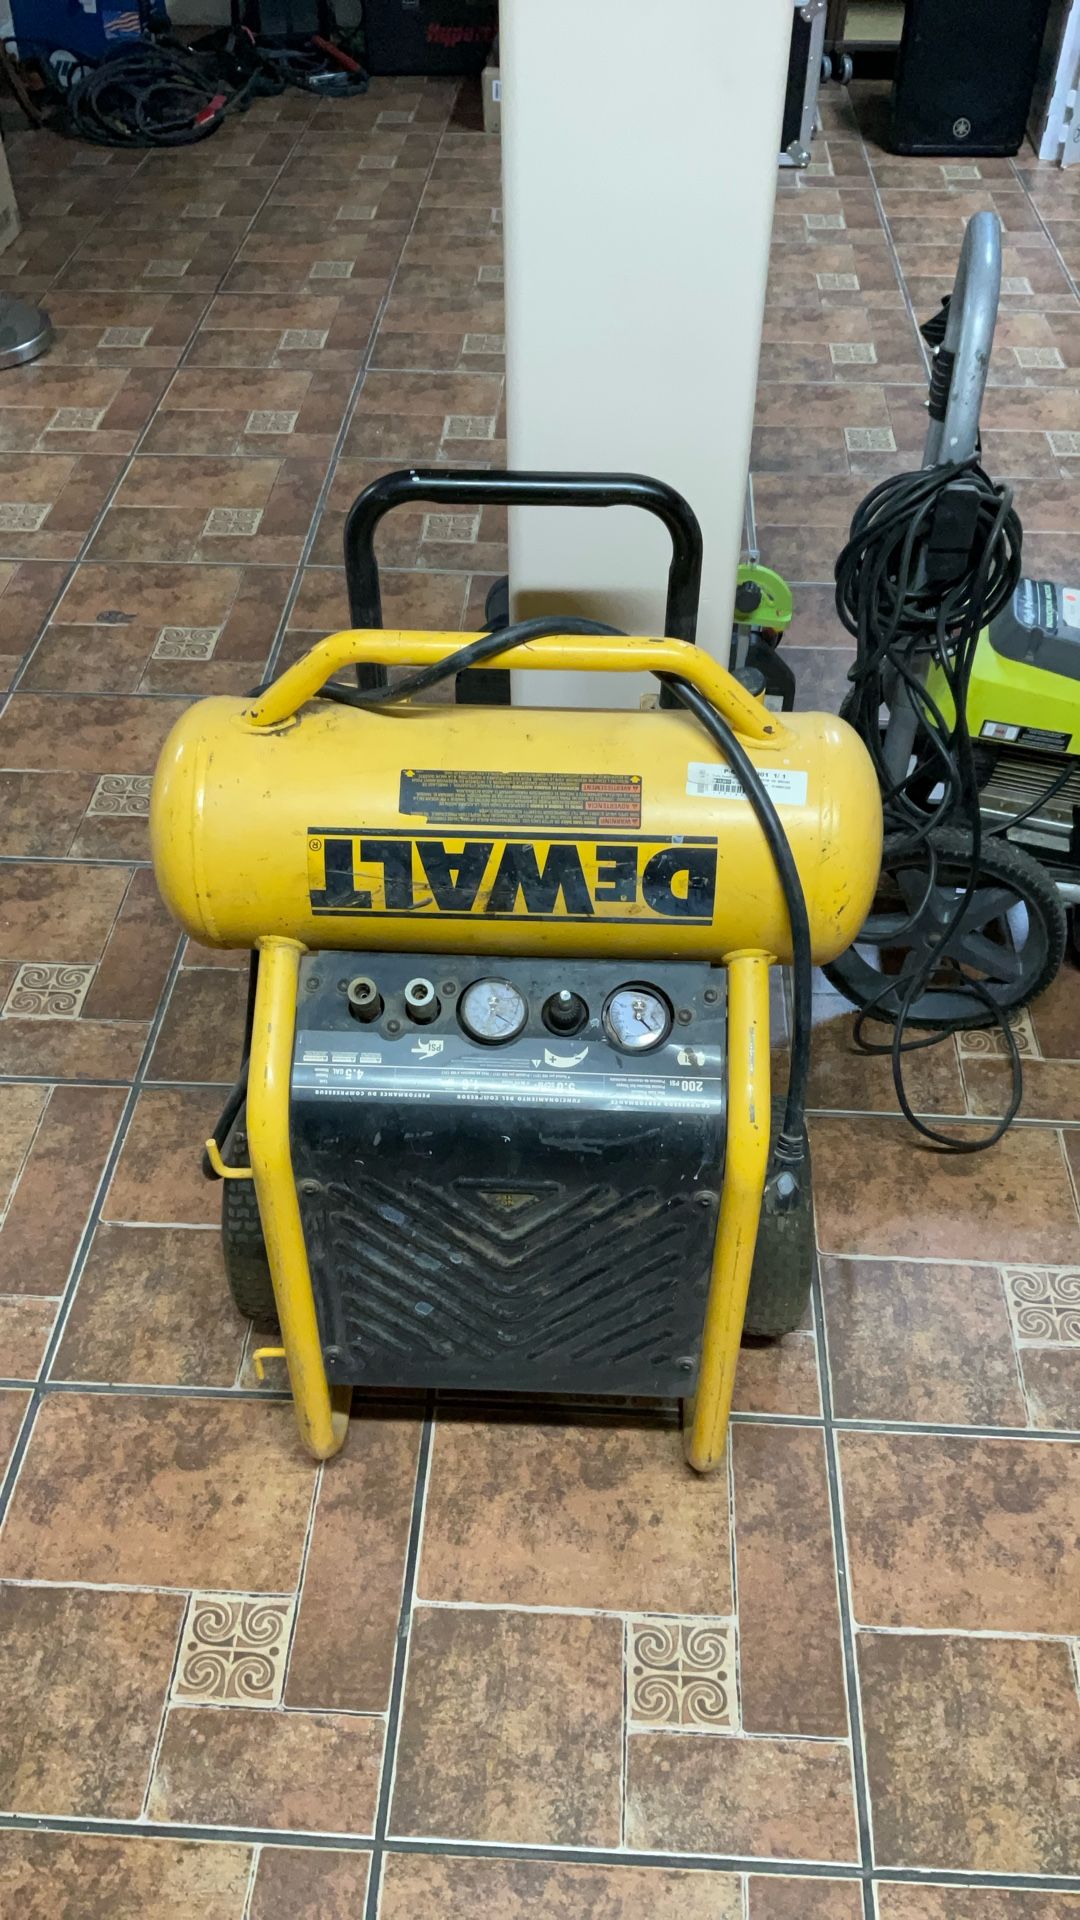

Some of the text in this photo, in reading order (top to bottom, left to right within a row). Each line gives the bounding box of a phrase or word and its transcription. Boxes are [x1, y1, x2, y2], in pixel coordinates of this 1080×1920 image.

[587, 802, 630, 810] ADVERTENCIA
[309, 838, 718, 917] DEWALT
[428, 1043, 442, 1052] PSI
[333, 1067, 365, 1080] 4.5 GAL
[681, 1080, 704, 1092] 200
[518, 1095, 580, 1104] FUNCIONAMIENTO
